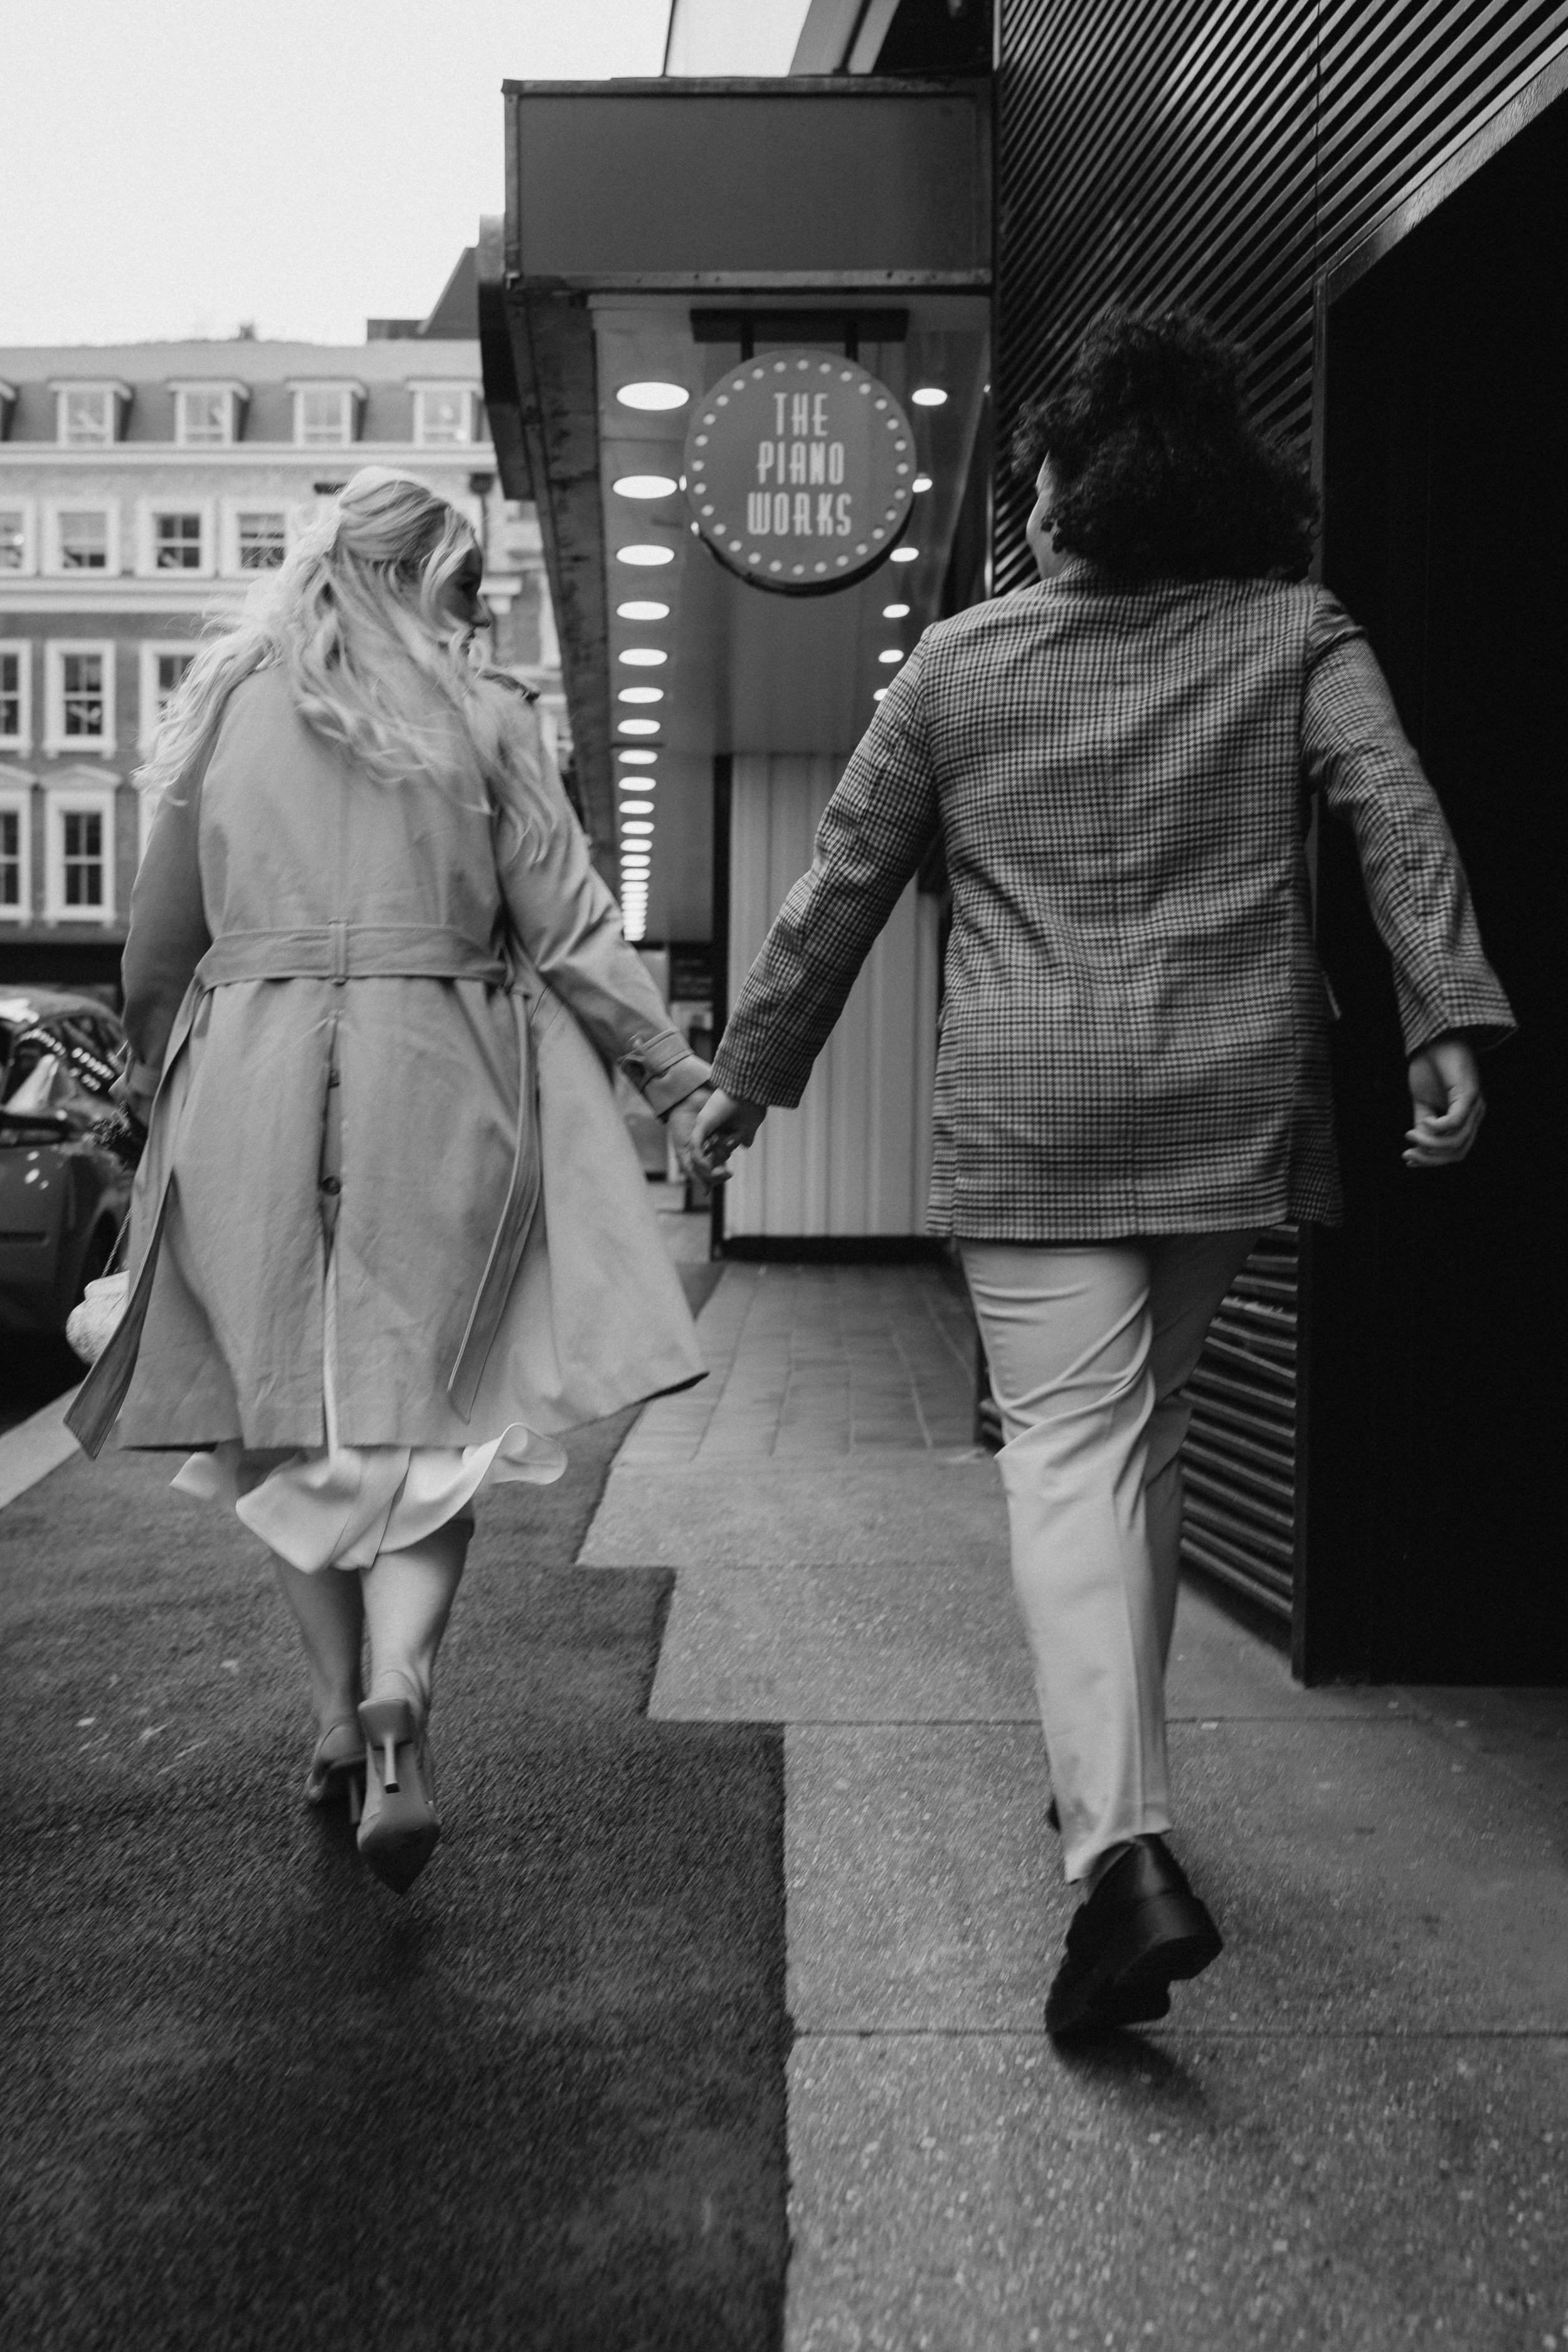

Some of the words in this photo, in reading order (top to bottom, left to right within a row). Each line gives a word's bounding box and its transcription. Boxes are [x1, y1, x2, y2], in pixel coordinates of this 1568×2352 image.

[773, 392, 829, 437] THE
[757, 441, 845, 485] PIANO
[747, 492, 852, 536] WORKS
